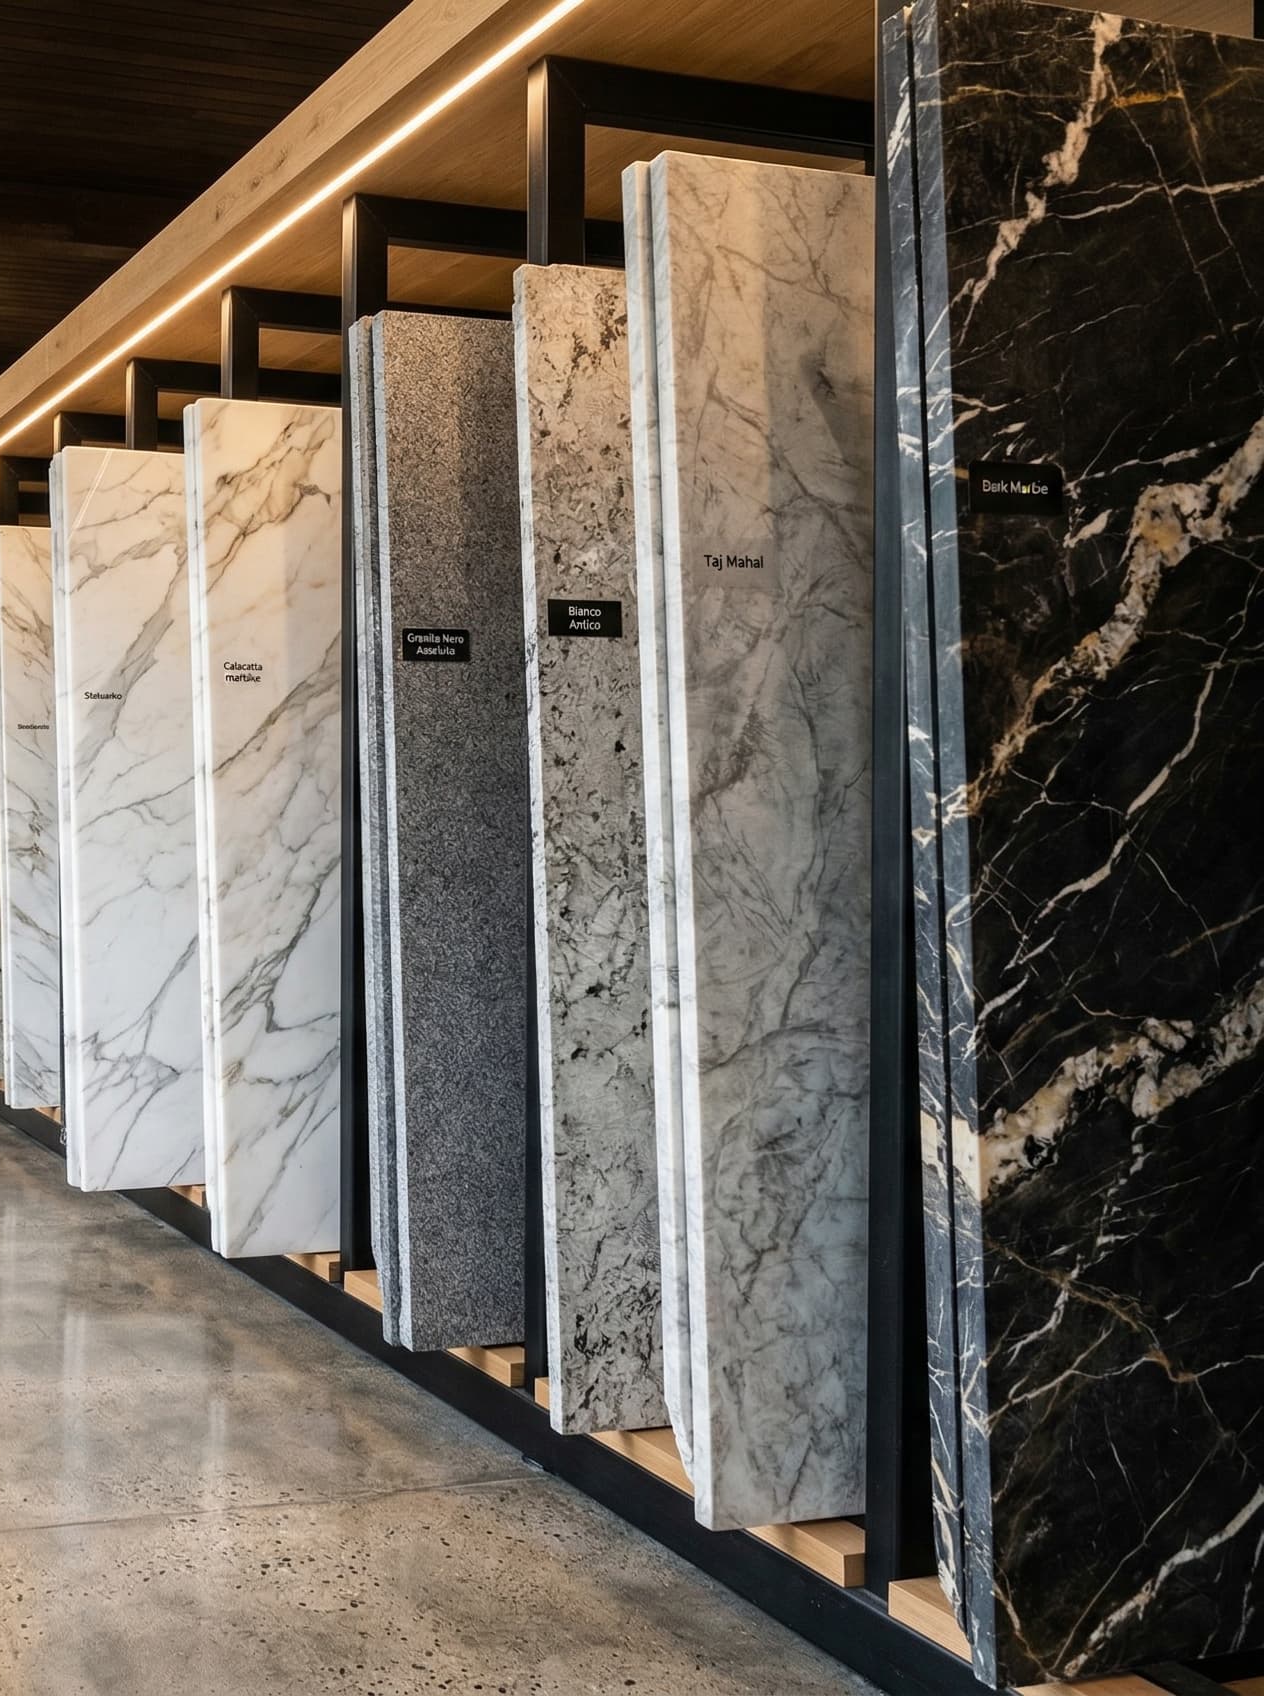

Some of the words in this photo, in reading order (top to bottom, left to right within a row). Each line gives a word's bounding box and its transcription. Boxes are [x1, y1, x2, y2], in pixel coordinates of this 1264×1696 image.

[982, 480, 1008, 493] Dark
[703, 554, 723, 571] Taj
[726, 555, 764, 569] Mahal
[568, 606, 602, 617] Bianco
[568, 619, 601, 630] Antico
[442, 633, 465, 644] Nero
